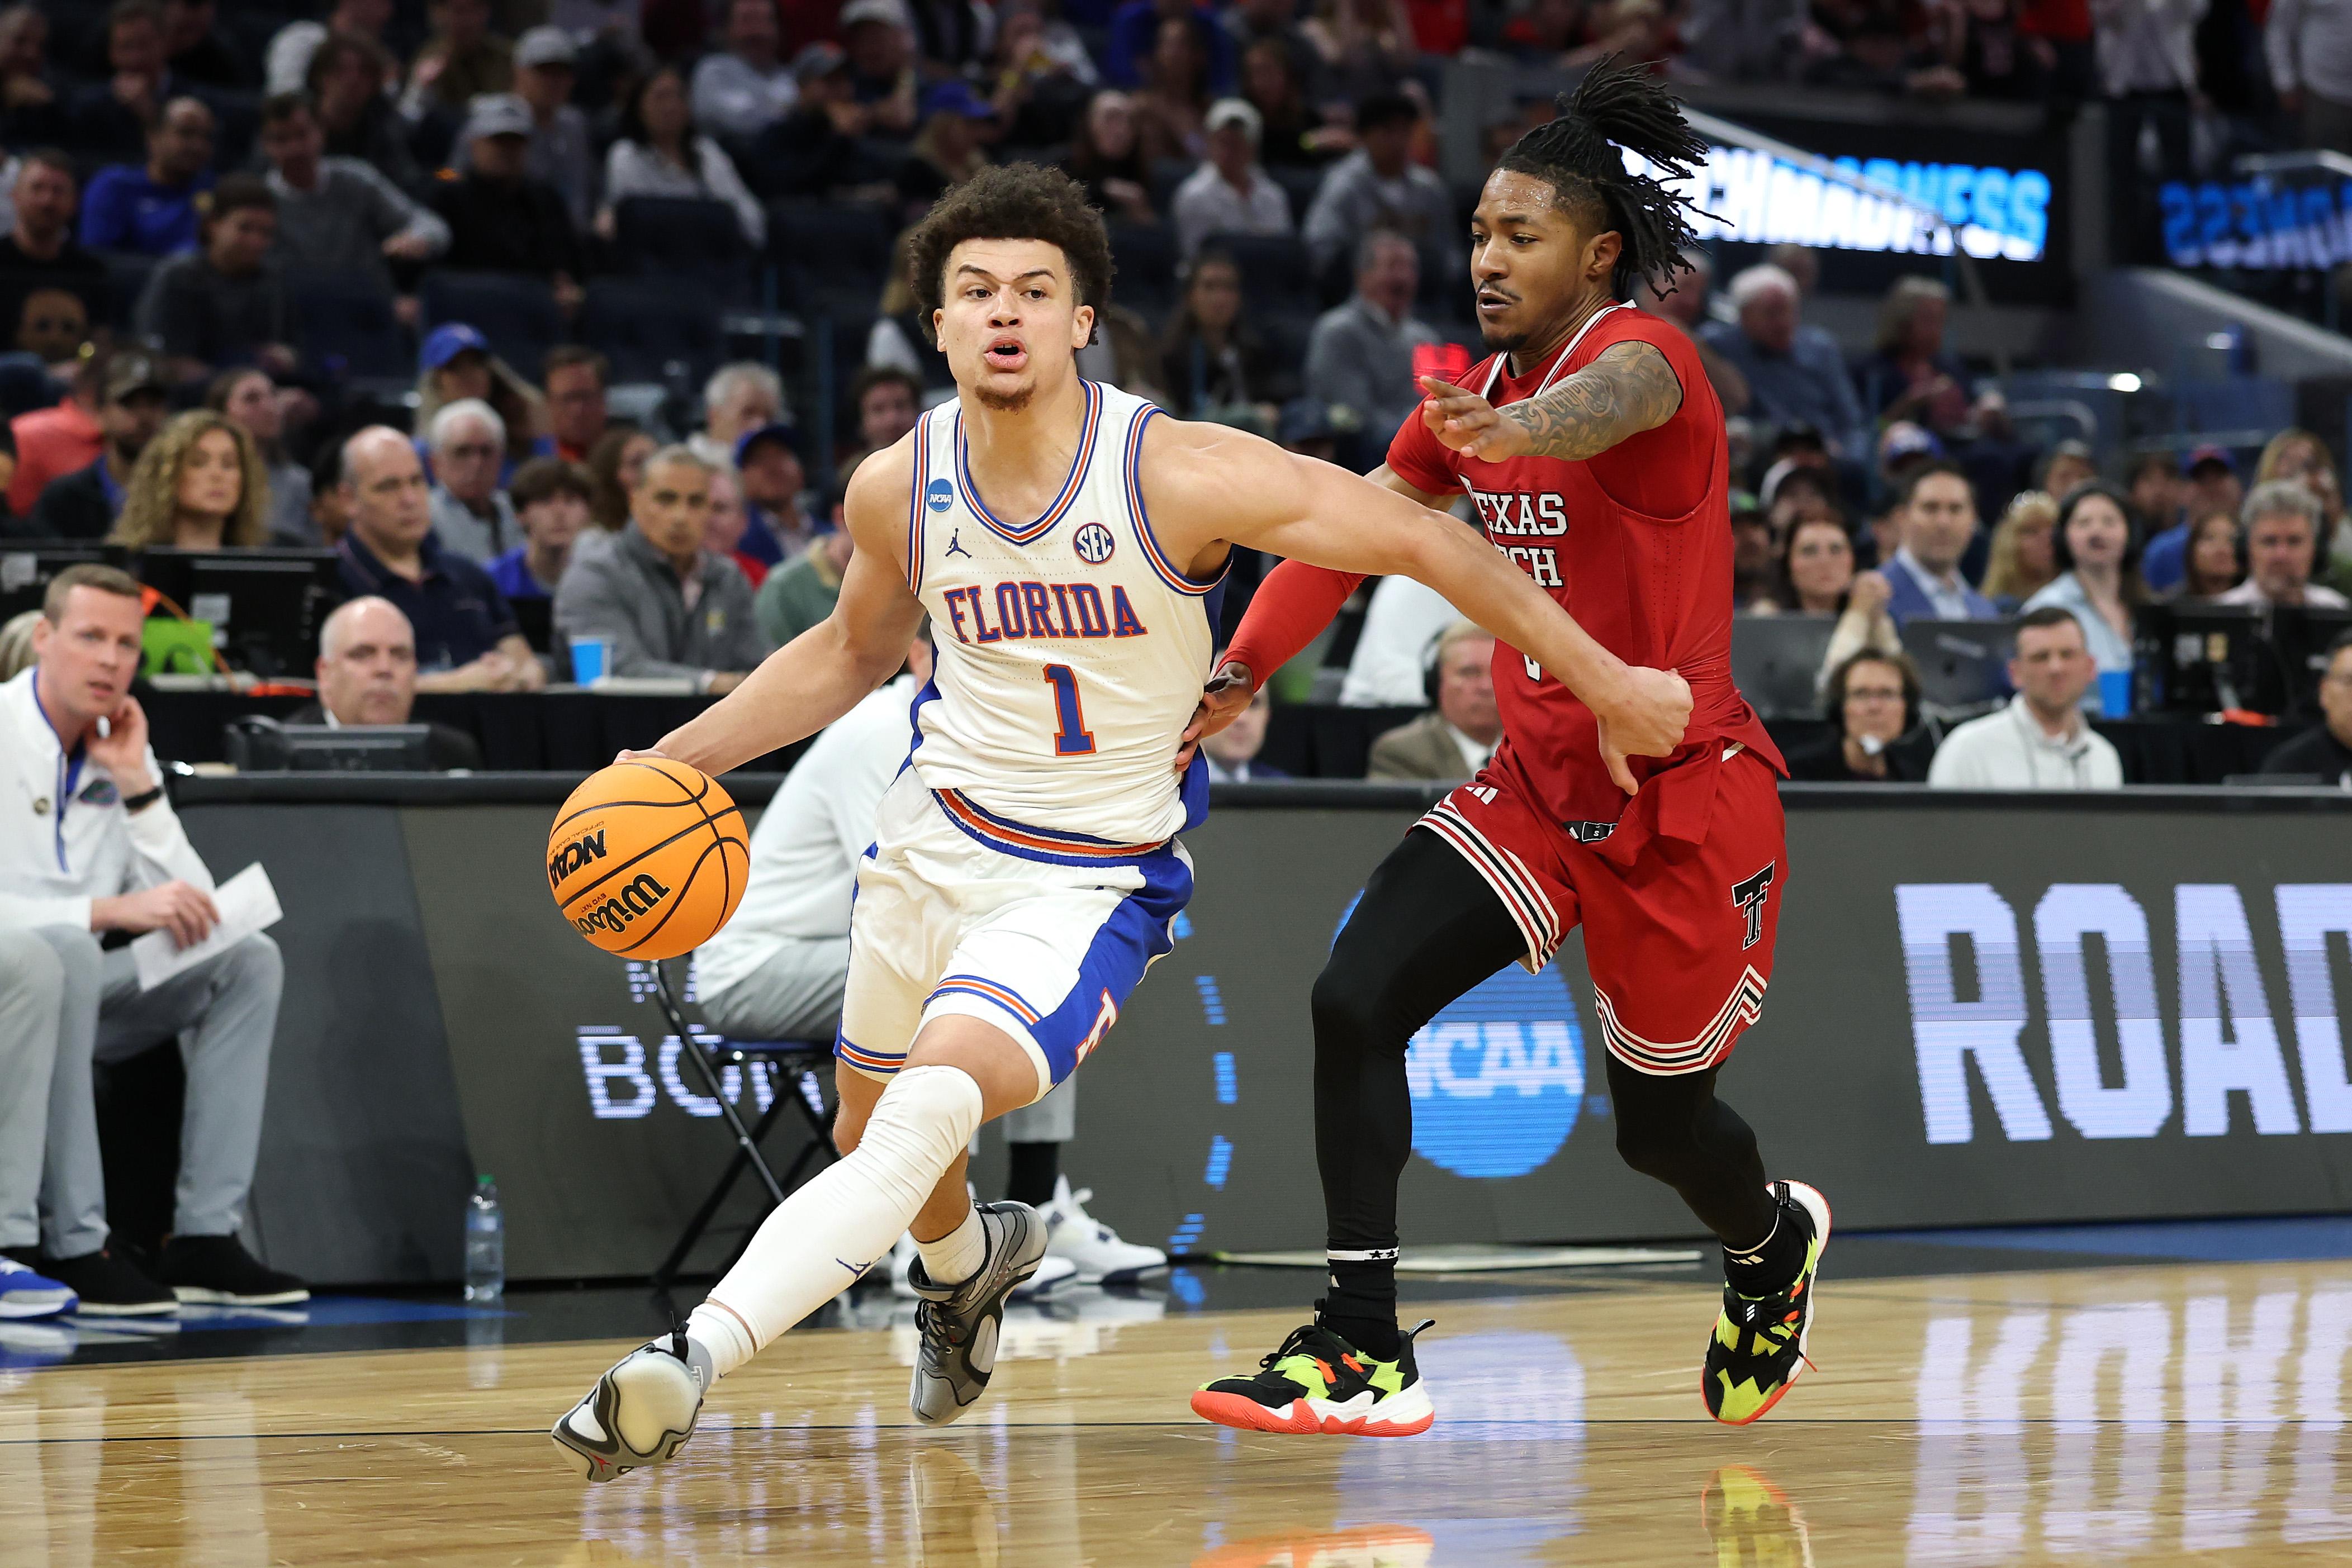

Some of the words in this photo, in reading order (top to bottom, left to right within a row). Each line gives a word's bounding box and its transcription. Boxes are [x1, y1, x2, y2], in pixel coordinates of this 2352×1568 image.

[930, 493, 951, 503] NCAA
[1076, 524, 1112, 562] SEC
[943, 581, 1148, 644] FLORIDA
[1043, 663, 1096, 756] 1
[549, 828, 608, 890] NCAA
[567, 872, 671, 938] Wilson
[581, 902, 592, 913] NXT
[592, 892, 606, 905] EVO
